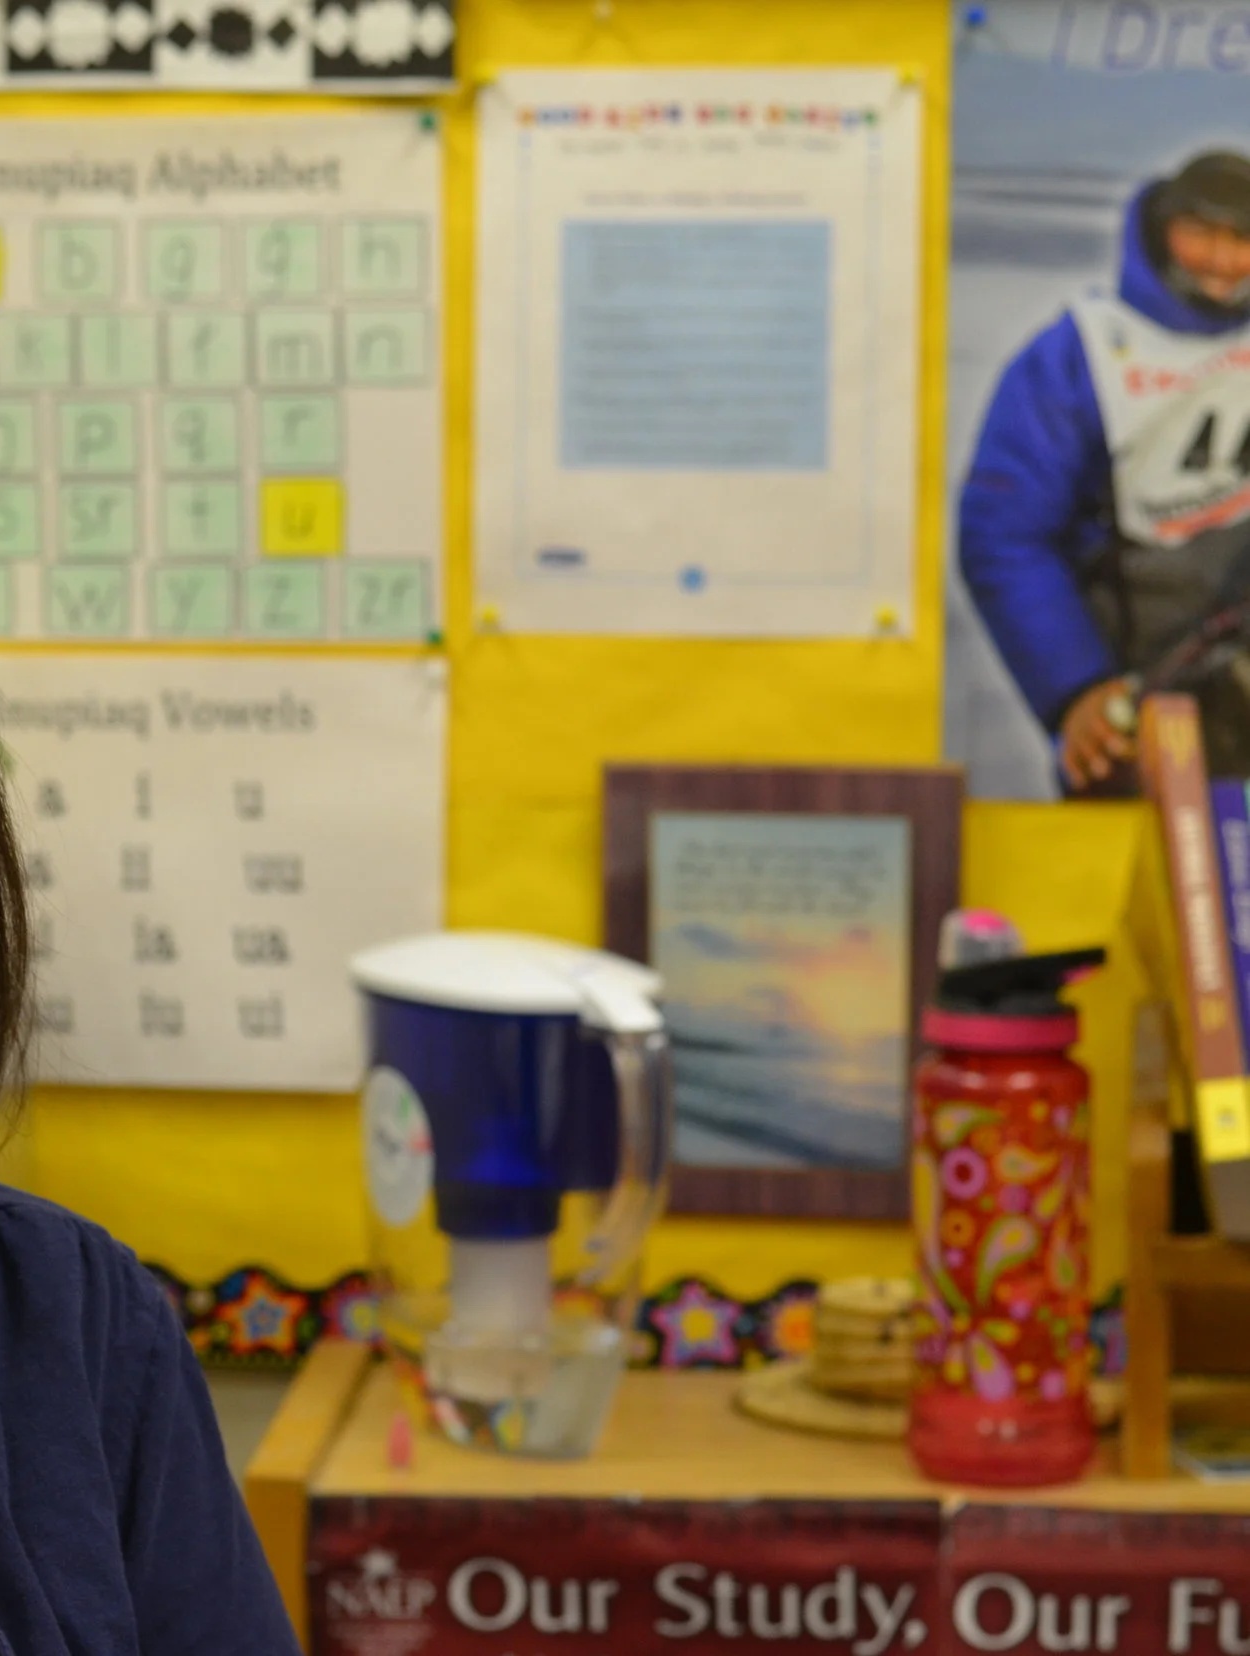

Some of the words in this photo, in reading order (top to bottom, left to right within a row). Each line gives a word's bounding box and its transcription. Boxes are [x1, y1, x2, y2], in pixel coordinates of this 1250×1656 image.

[147, 147, 341, 204] Alphabet
[58, 226, 100, 290] b
[265, 328, 326, 378] m
[159, 688, 317, 735] Vowels
[232, 780, 266, 822] u
[447, 1556, 618, 1634] Our
[653, 1561, 927, 1656] Study,
[952, 1571, 1132, 1653] Our
[1168, 1576, 1250, 1656] Fu
